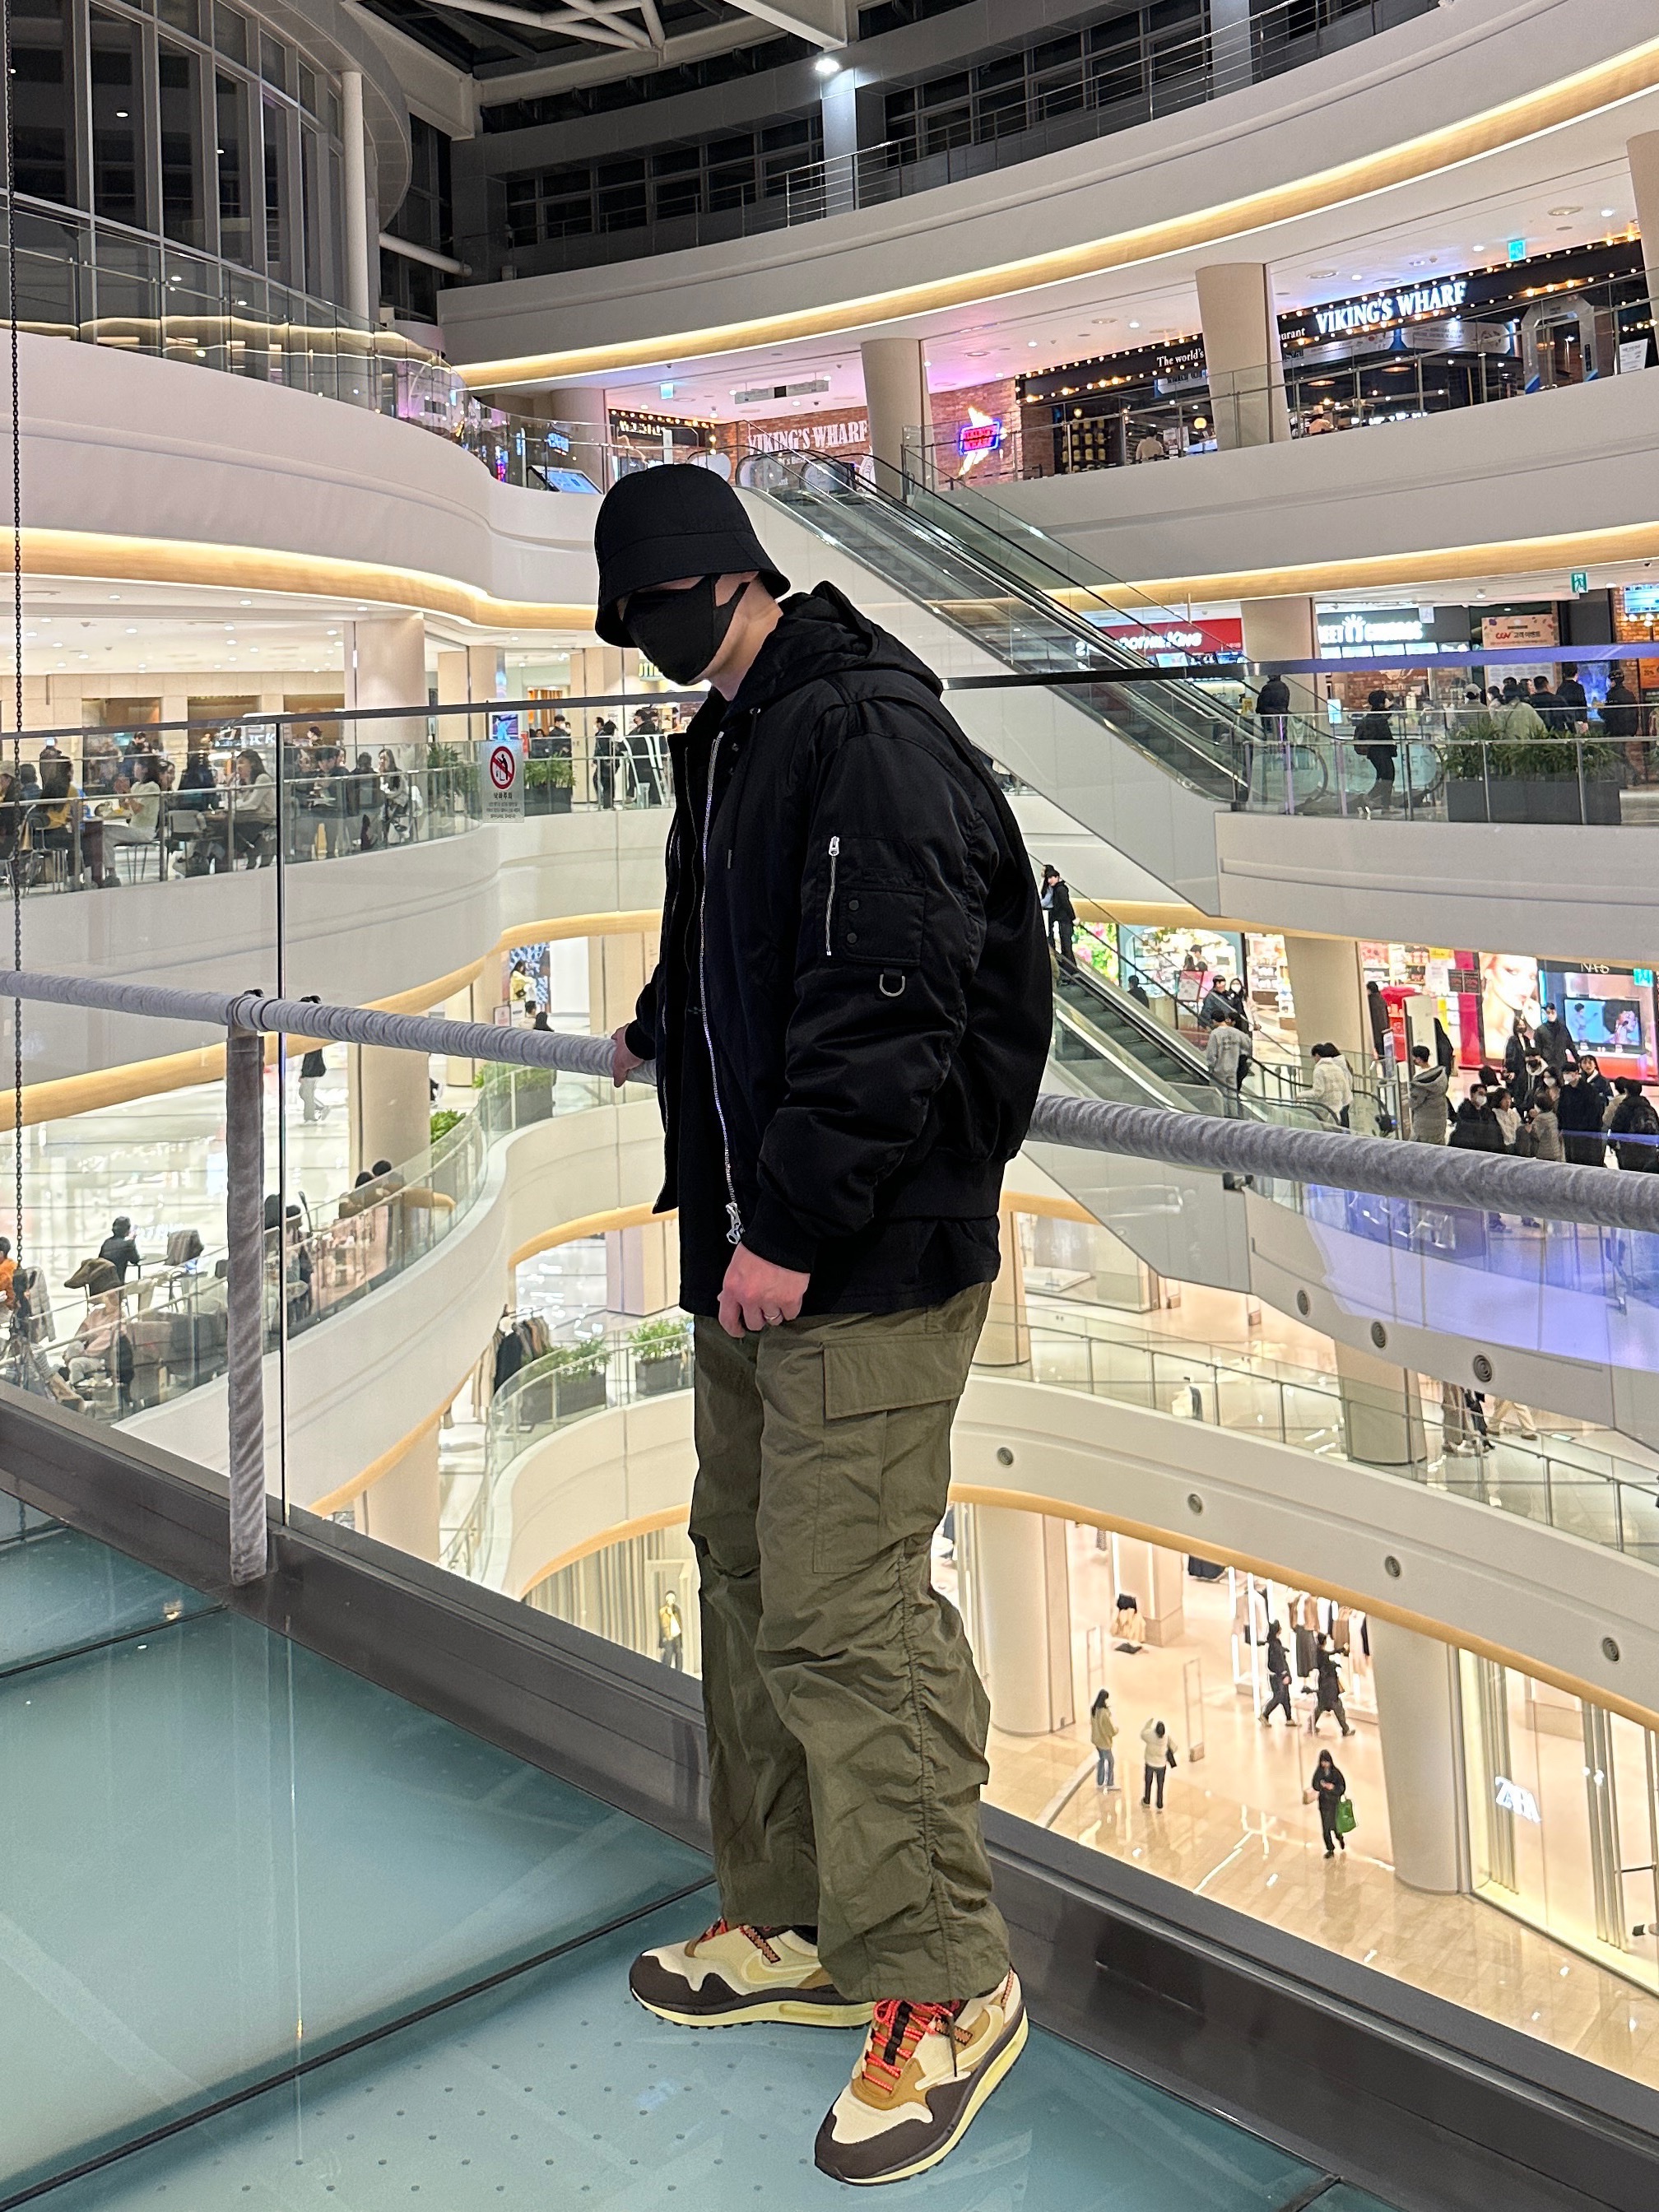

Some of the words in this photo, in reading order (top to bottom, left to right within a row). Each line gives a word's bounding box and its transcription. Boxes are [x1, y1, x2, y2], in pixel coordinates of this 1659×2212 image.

[1316, 297, 1394, 334] VIKING'S
[1396, 281, 1467, 317] WHARF
[1156, 356, 1173, 367] The
[1175, 348, 1204, 363] world's
[748, 427, 811, 455] VIKING'S
[812, 420, 868, 448] WHARF
[1494, 1776, 1541, 1824] ZARA
